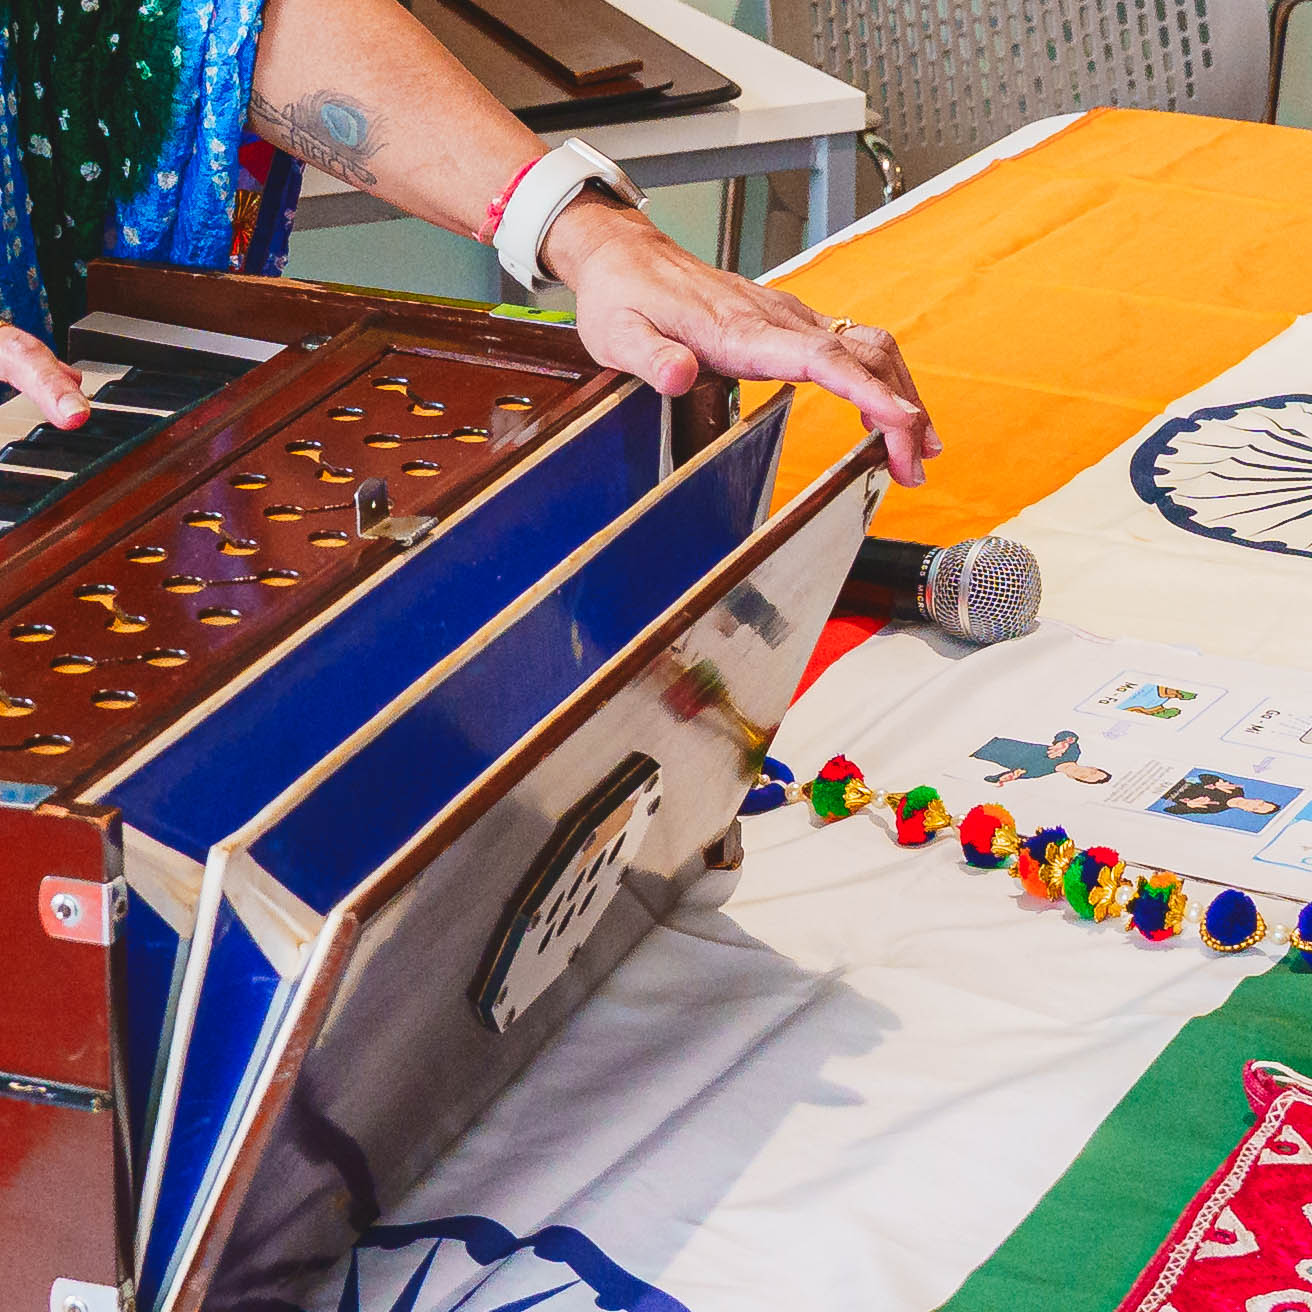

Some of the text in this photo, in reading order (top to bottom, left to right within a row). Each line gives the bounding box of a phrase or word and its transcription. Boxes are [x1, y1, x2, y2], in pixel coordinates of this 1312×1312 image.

[1116, 681, 1139, 692] Ma
[1098, 696, 1119, 705] Fa
[1261, 709, 1281, 720] Ga
